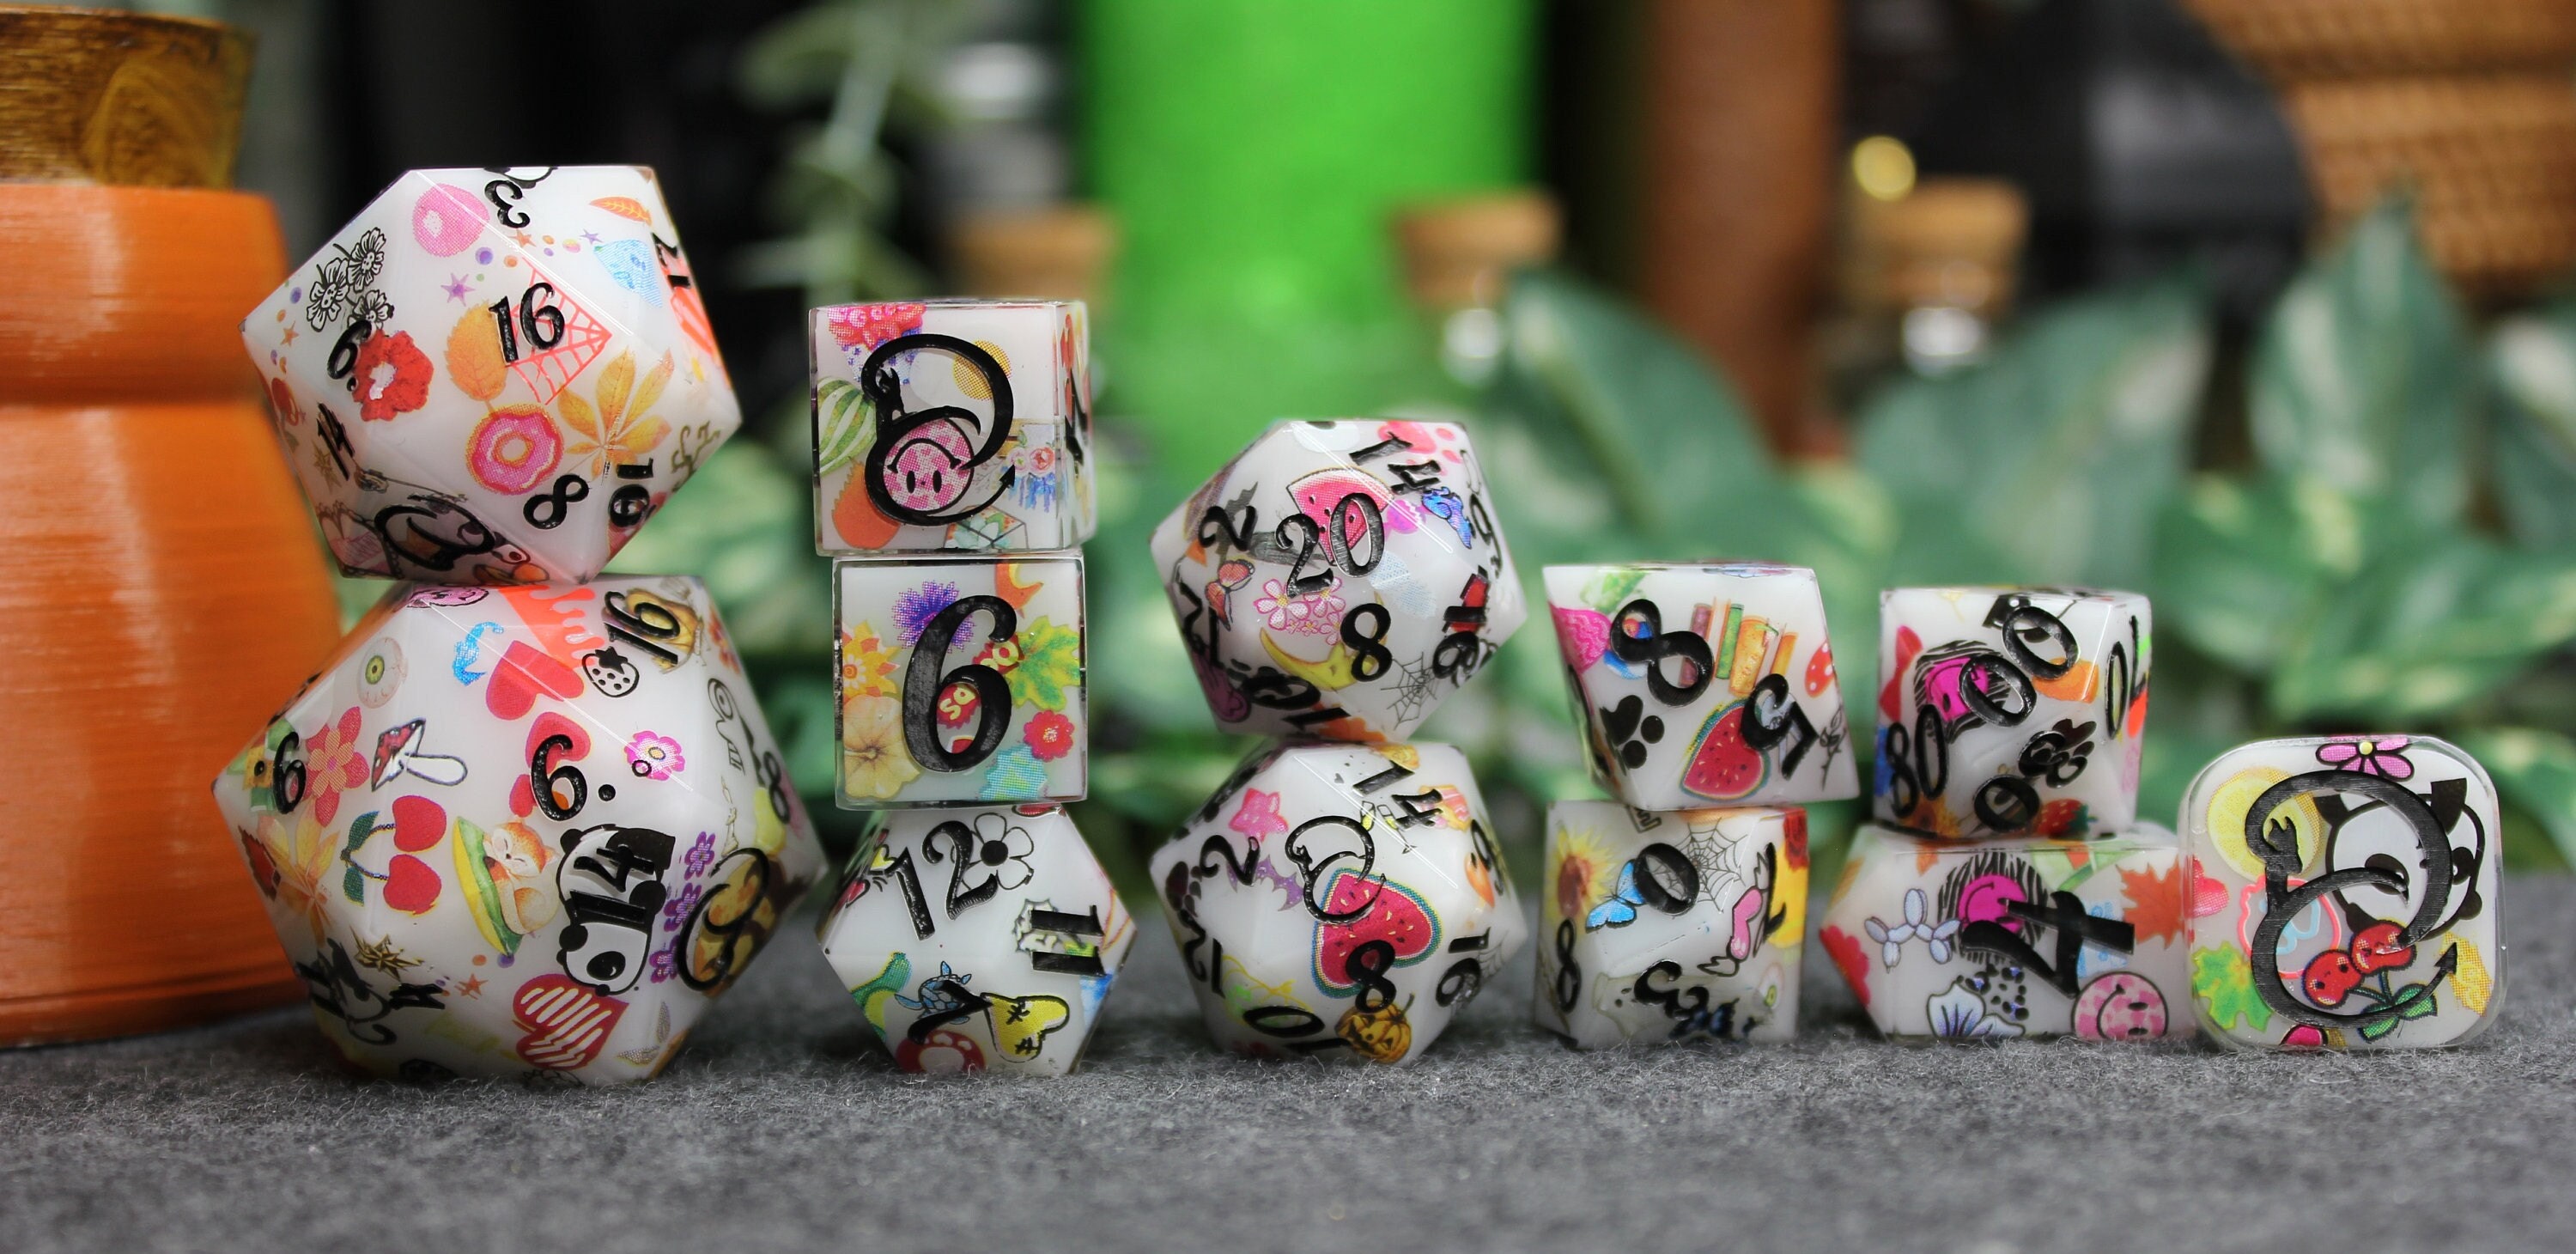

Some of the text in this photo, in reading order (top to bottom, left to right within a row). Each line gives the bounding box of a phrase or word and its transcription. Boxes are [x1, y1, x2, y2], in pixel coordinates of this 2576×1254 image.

[489, 282, 565, 367] 16
[523, 473, 590, 530] 8
[1350, 432, 1442, 496] 14
[1199, 505, 1257, 552] 2
[1275, 492, 1385, 599] 20
[605, 591, 682, 667] 16
[1340, 603, 1393, 683] 8
[1610, 599, 1715, 708] 8
[1959, 606, 2081, 727] 00
[904, 594, 1018, 773] 6
[1740, 673, 1820, 781] 5
[1886, 704, 1949, 819] 80
[762, 751, 791, 825] 8
[1352, 759, 1443, 830] 14
[885, 820, 999, 941] 12
[1200, 835, 1261, 886] 2
[1633, 843, 1700, 915] 0
[1030, 904, 1107, 977] 11
[1345, 940, 1396, 1014] 8
[1557, 918, 1583, 1014] 8
[1961, 890, 2136, 1000] 4
